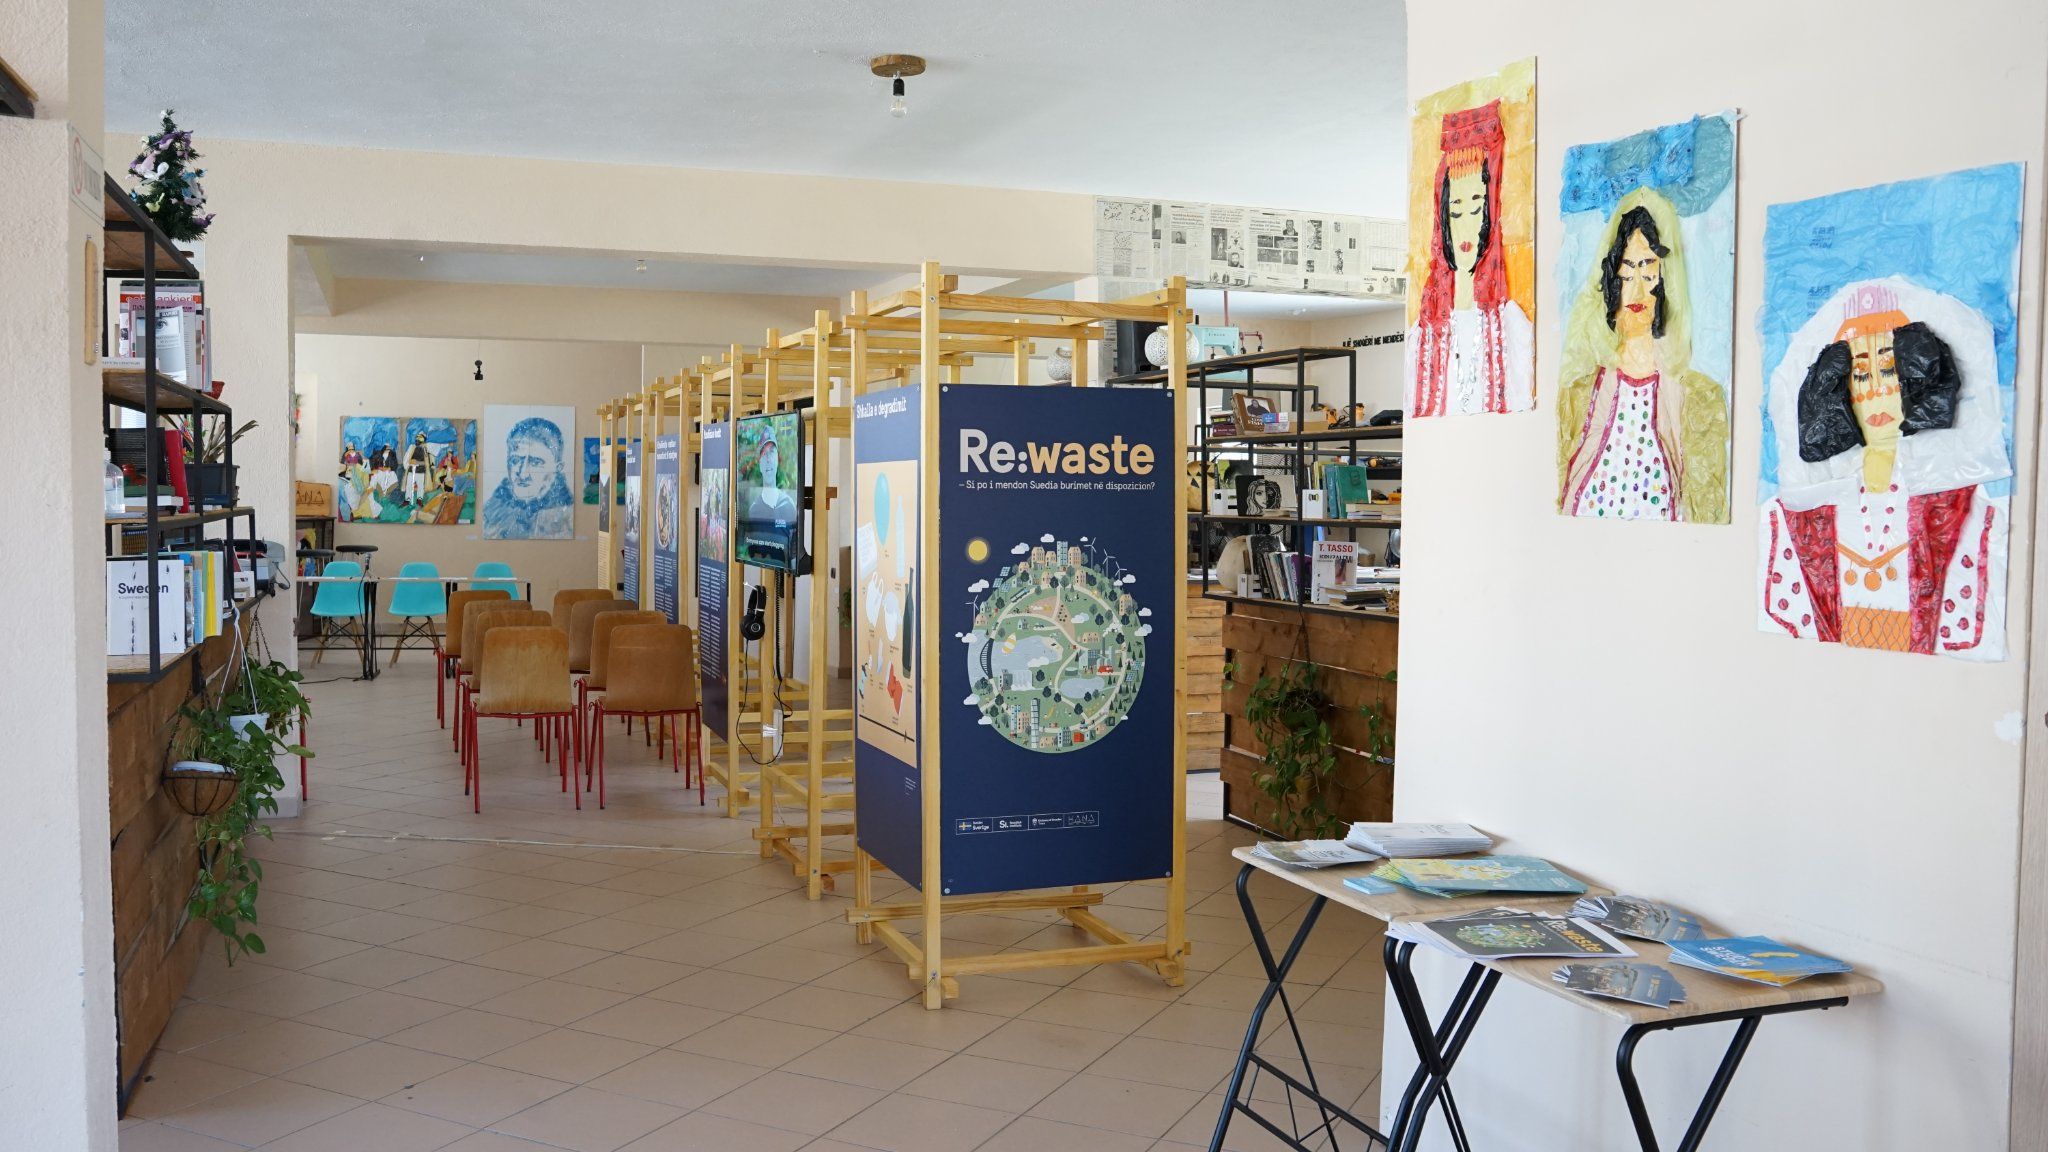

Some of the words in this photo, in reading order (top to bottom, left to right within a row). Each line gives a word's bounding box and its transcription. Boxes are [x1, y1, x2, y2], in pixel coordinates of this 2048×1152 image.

[959, 428, 1155, 475] Re:waste
[976, 481, 987, 490] po
[990, 480, 993, 488] i
[995, 480, 1028, 489] mendon
[1030, 480, 1058, 489] Suedia
[1060, 480, 1092, 490] burimet
[1094, 481, 1104, 489] në
[1105, 481, 1156, 491] dispozicion?
[1319, 544, 1325, 552] T.
[1327, 544, 1353, 553] TASSO
[118, 582, 169, 594] Swen
